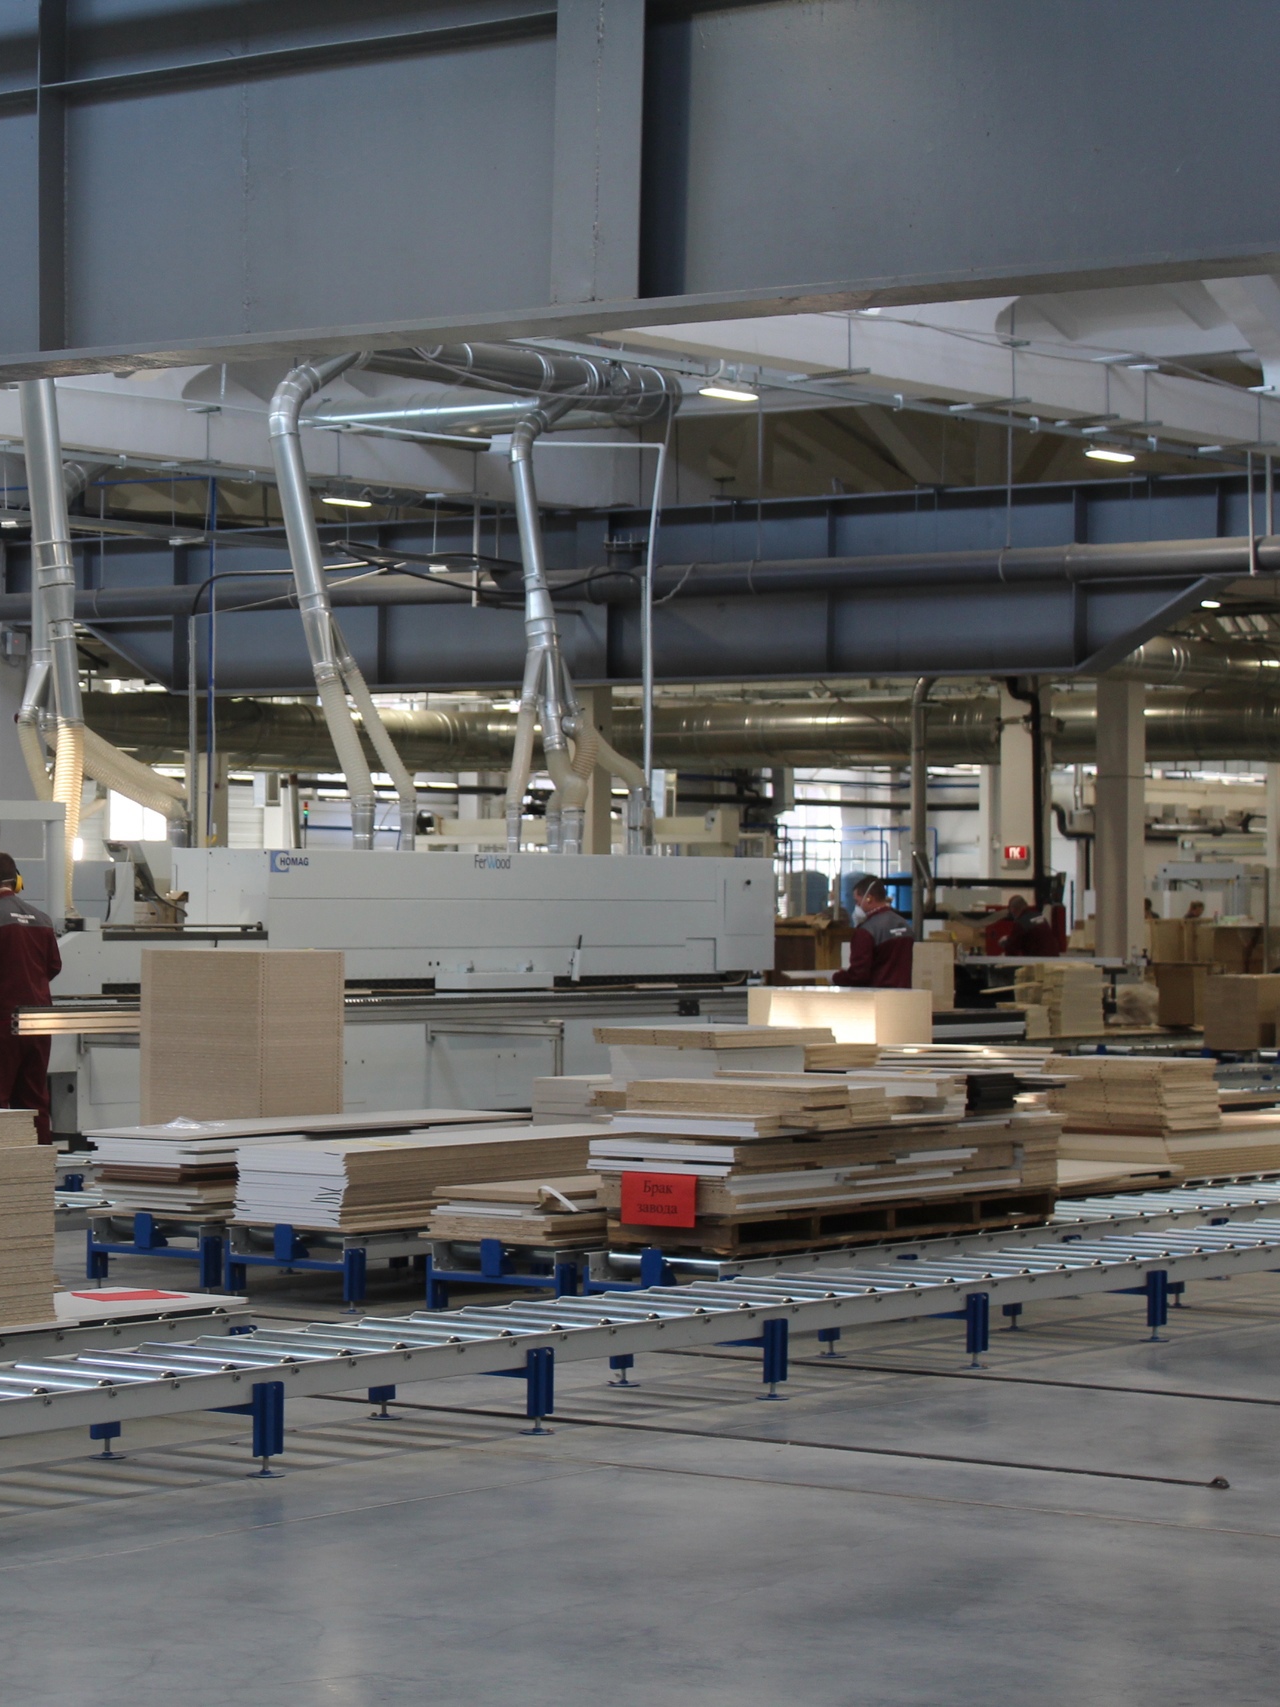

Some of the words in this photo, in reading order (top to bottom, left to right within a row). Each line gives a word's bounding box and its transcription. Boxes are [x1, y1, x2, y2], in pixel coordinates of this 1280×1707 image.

[279, 856, 309, 866] HOMAG
[474, 854, 511, 869] FerWood
[643, 1181, 673, 1197] Брак
[636, 1203, 678, 1215] завода
